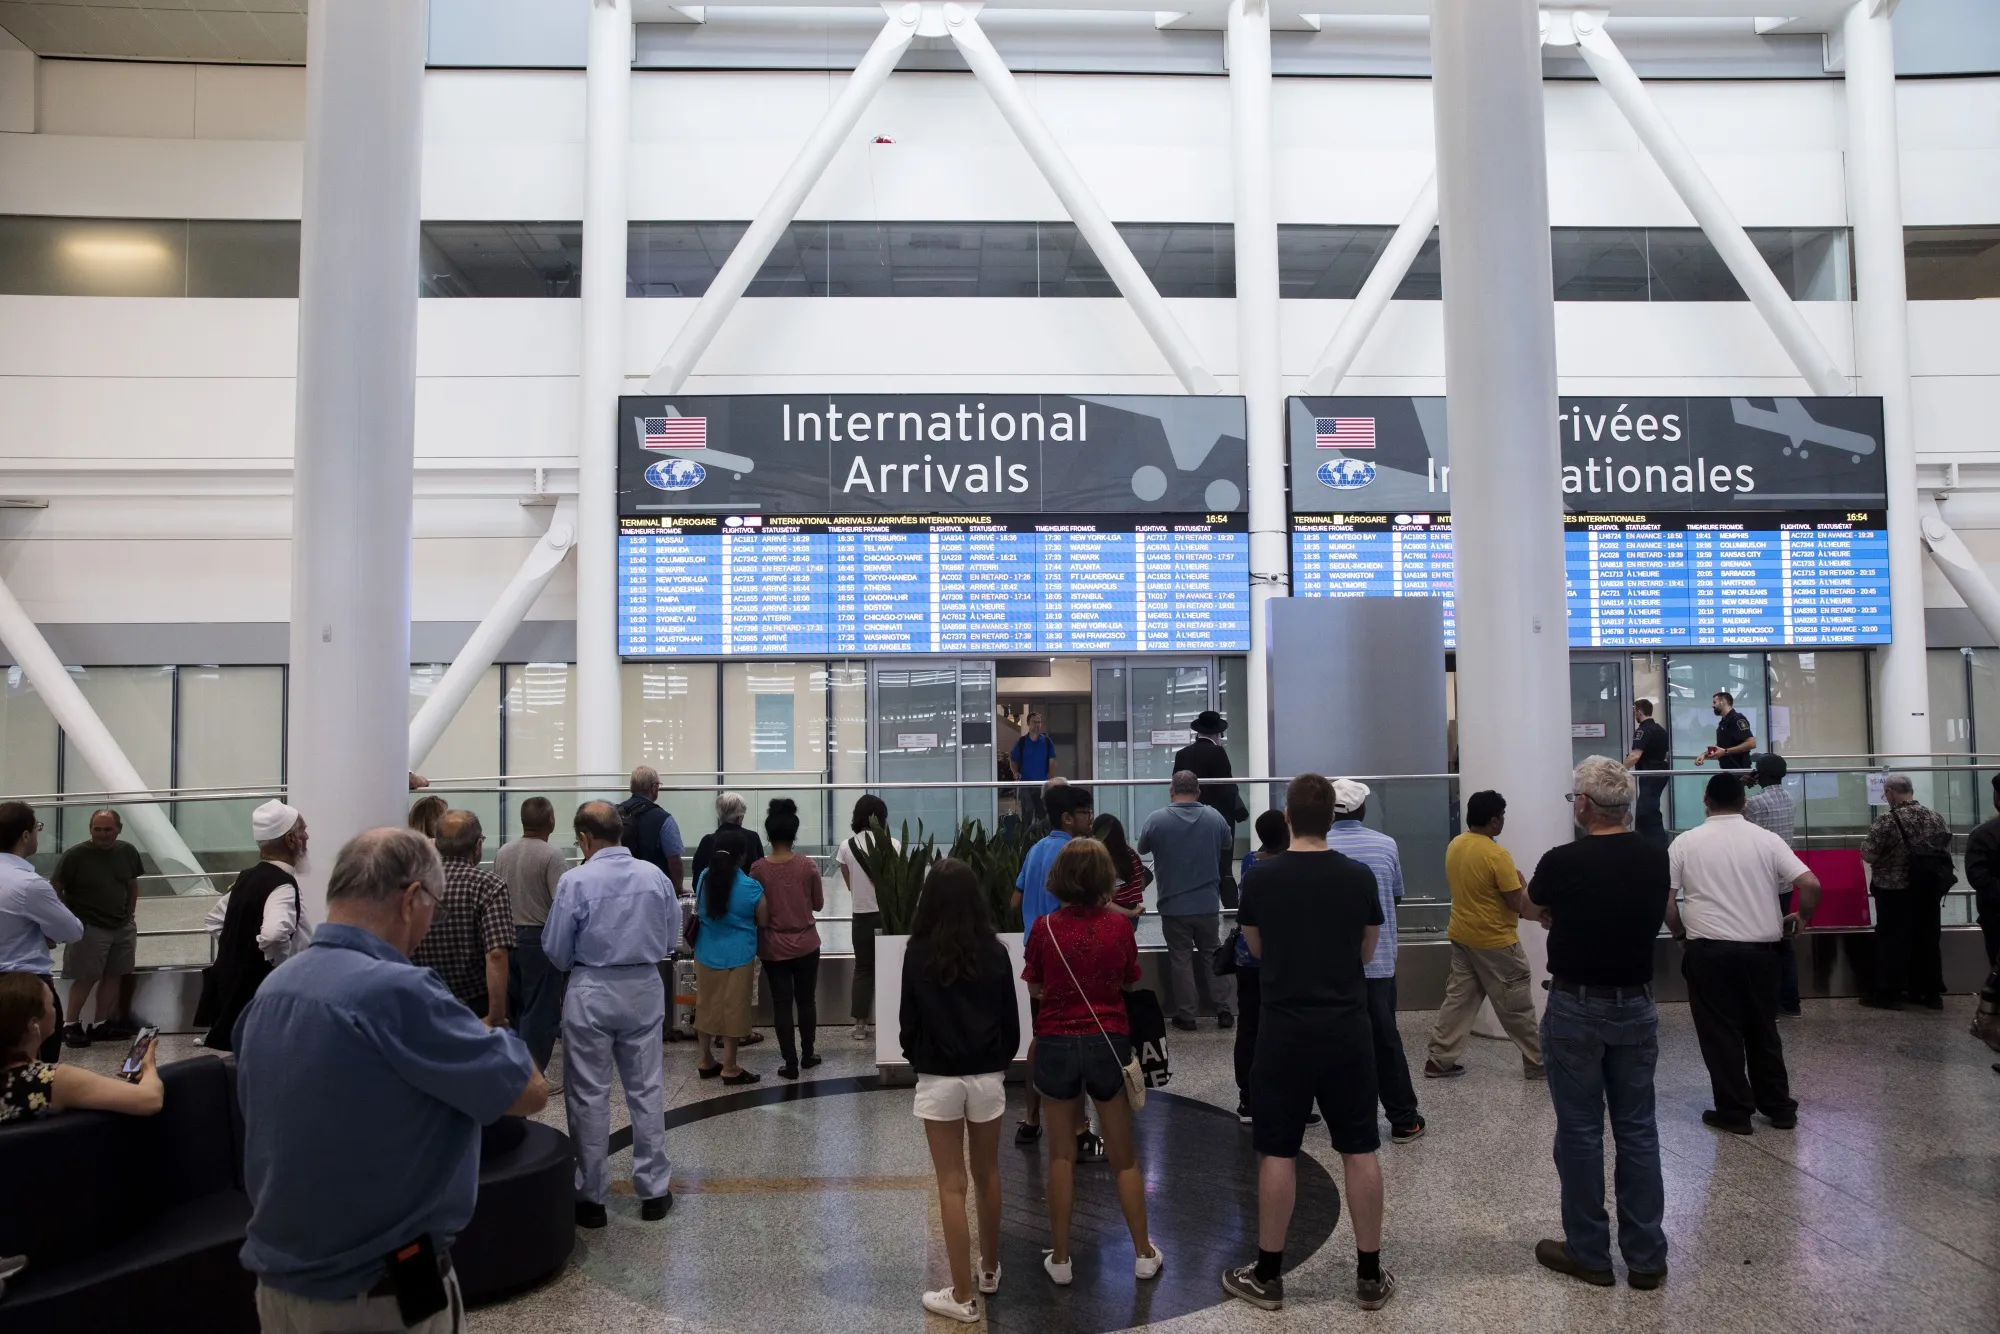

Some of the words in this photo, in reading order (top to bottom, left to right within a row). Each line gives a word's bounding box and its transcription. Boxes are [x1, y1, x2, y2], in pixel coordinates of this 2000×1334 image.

[783, 403, 1086, 442] International
[843, 454, 1029, 493] Arrivals
[621, 519, 660, 527] TERMINAL
[672, 518, 717, 526] AÉROGARE
[770, 516, 832, 525] INTERNATIONAL
[833, 517, 872, 525] ARRIVALS
[878, 516, 918, 524] ARRIVÉES
[1206, 515, 1228, 523] 16:54
[1344, 515, 1387, 523] AÉROGARE
[762, 534, 787, 542] ARRIVÉ
[969, 533, 995, 541] ARRIVÉ
[762, 544, 787, 552] ARRIVÉ
[969, 542, 995, 551] ARRIVÉ
[762, 554, 787, 562] ARRIVÉ
[969, 552, 995, 561] ARRIVÉ
[762, 574, 788, 582] ARRIVÉ
[762, 583, 788, 592] ARRIVÉ
[969, 582, 995, 590] ARRIVÉ
[762, 593, 788, 602] ARRIVÉ
[762, 602, 788, 612] ARRIVÉ
[762, 633, 788, 642] ARRIVÉ
[762, 642, 788, 652] ARRIVÉ
